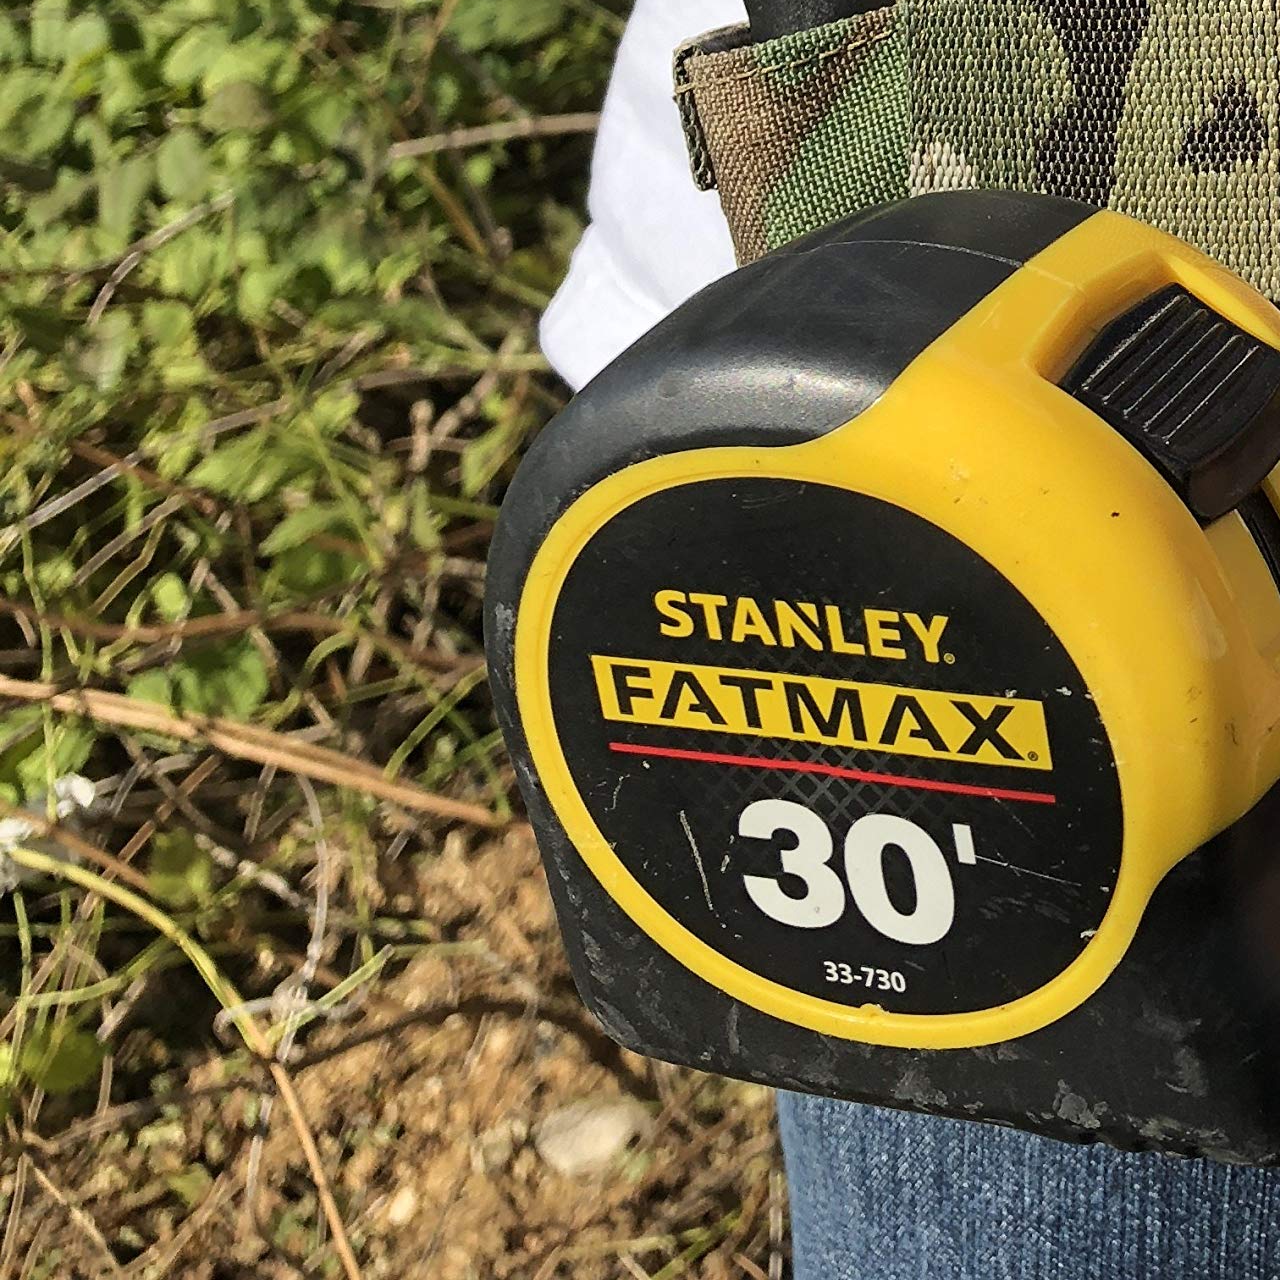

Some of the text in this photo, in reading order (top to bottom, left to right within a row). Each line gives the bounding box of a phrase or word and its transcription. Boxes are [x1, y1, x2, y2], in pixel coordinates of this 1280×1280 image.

[655, 589, 949, 664] STANLEY
[610, 663, 1025, 762] FATMAX
[824, 961, 907, 994] 33-730
